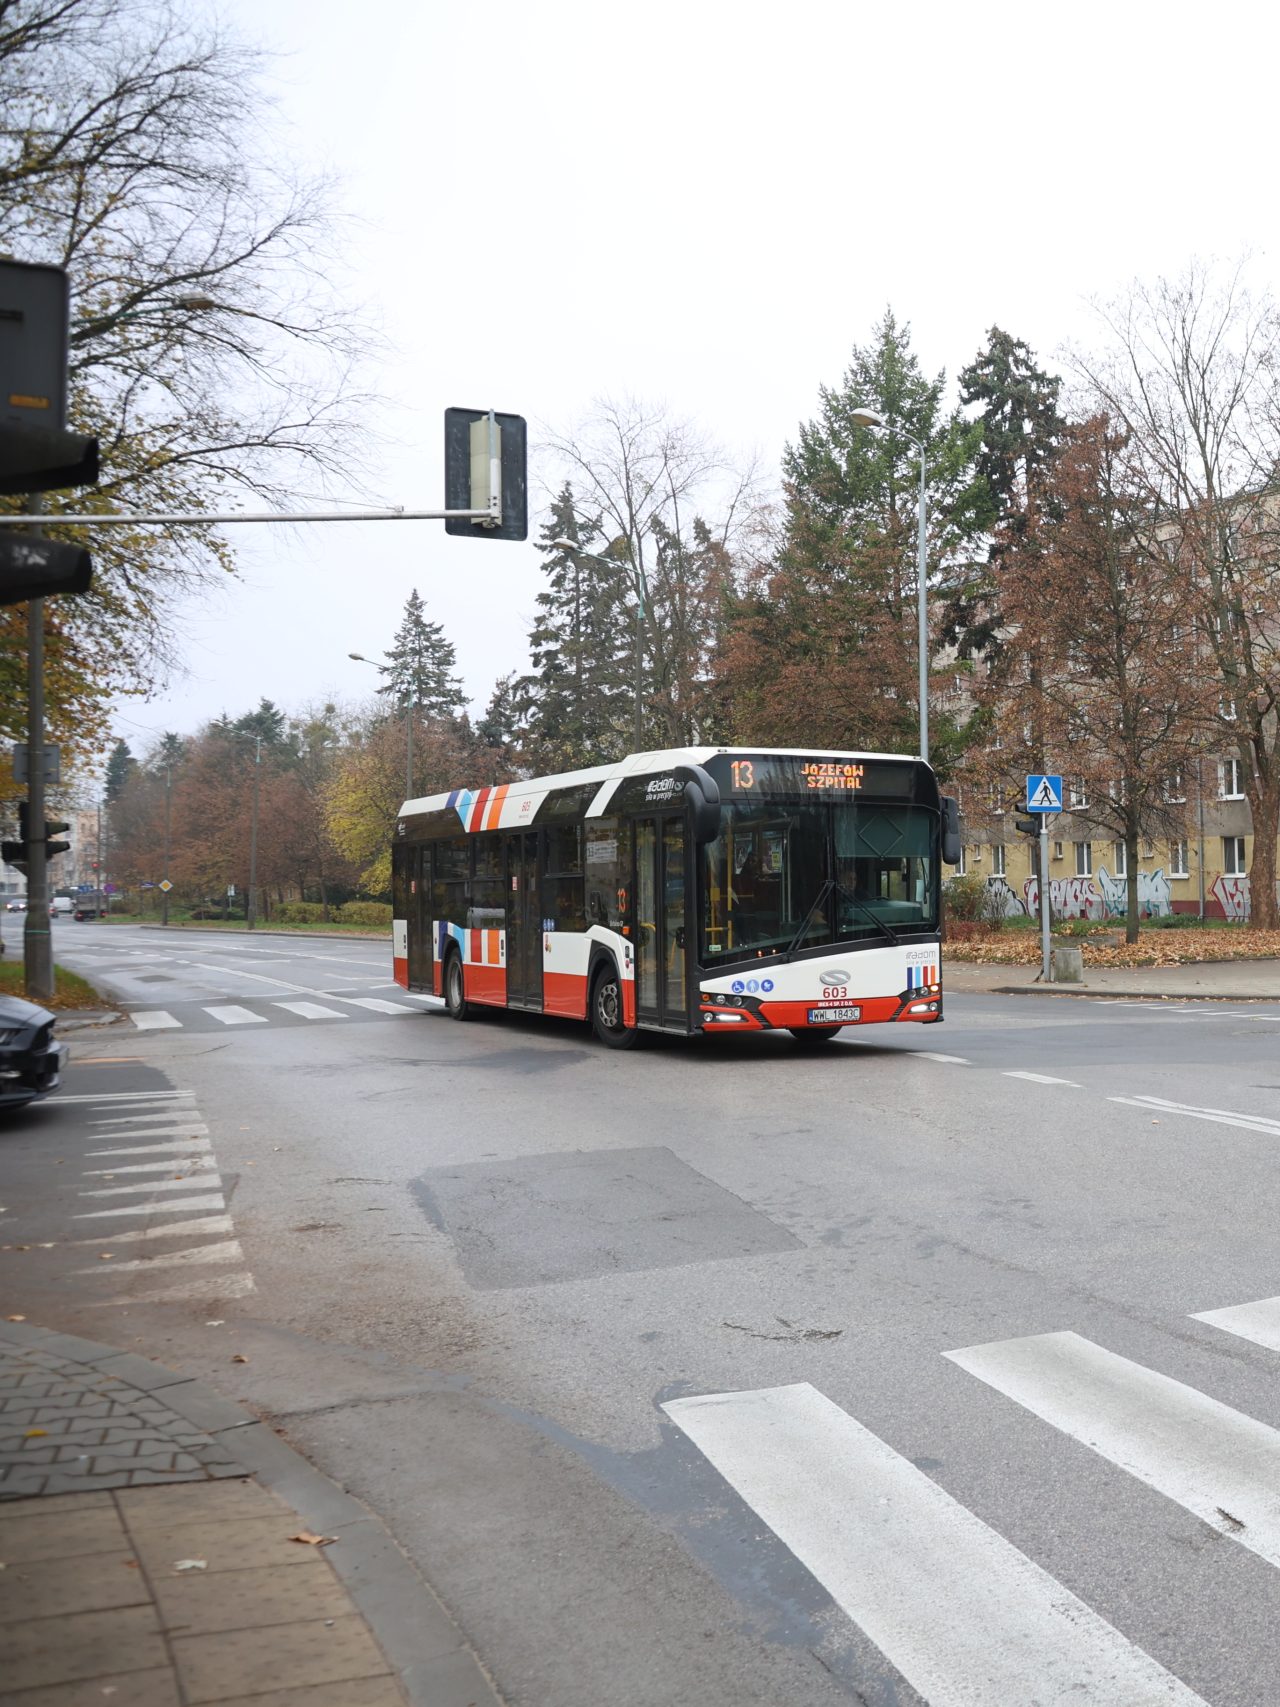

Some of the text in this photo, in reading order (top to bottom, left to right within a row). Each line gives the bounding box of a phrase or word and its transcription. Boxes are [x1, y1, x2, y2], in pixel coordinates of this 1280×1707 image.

[731, 760, 754, 788] 13
[801, 763, 864, 776] JÓZEFÓW
[807, 776, 862, 789] SZPITAL
[823, 987, 848, 999] 603
[814, 1008, 858, 1020] WWL 1843C
